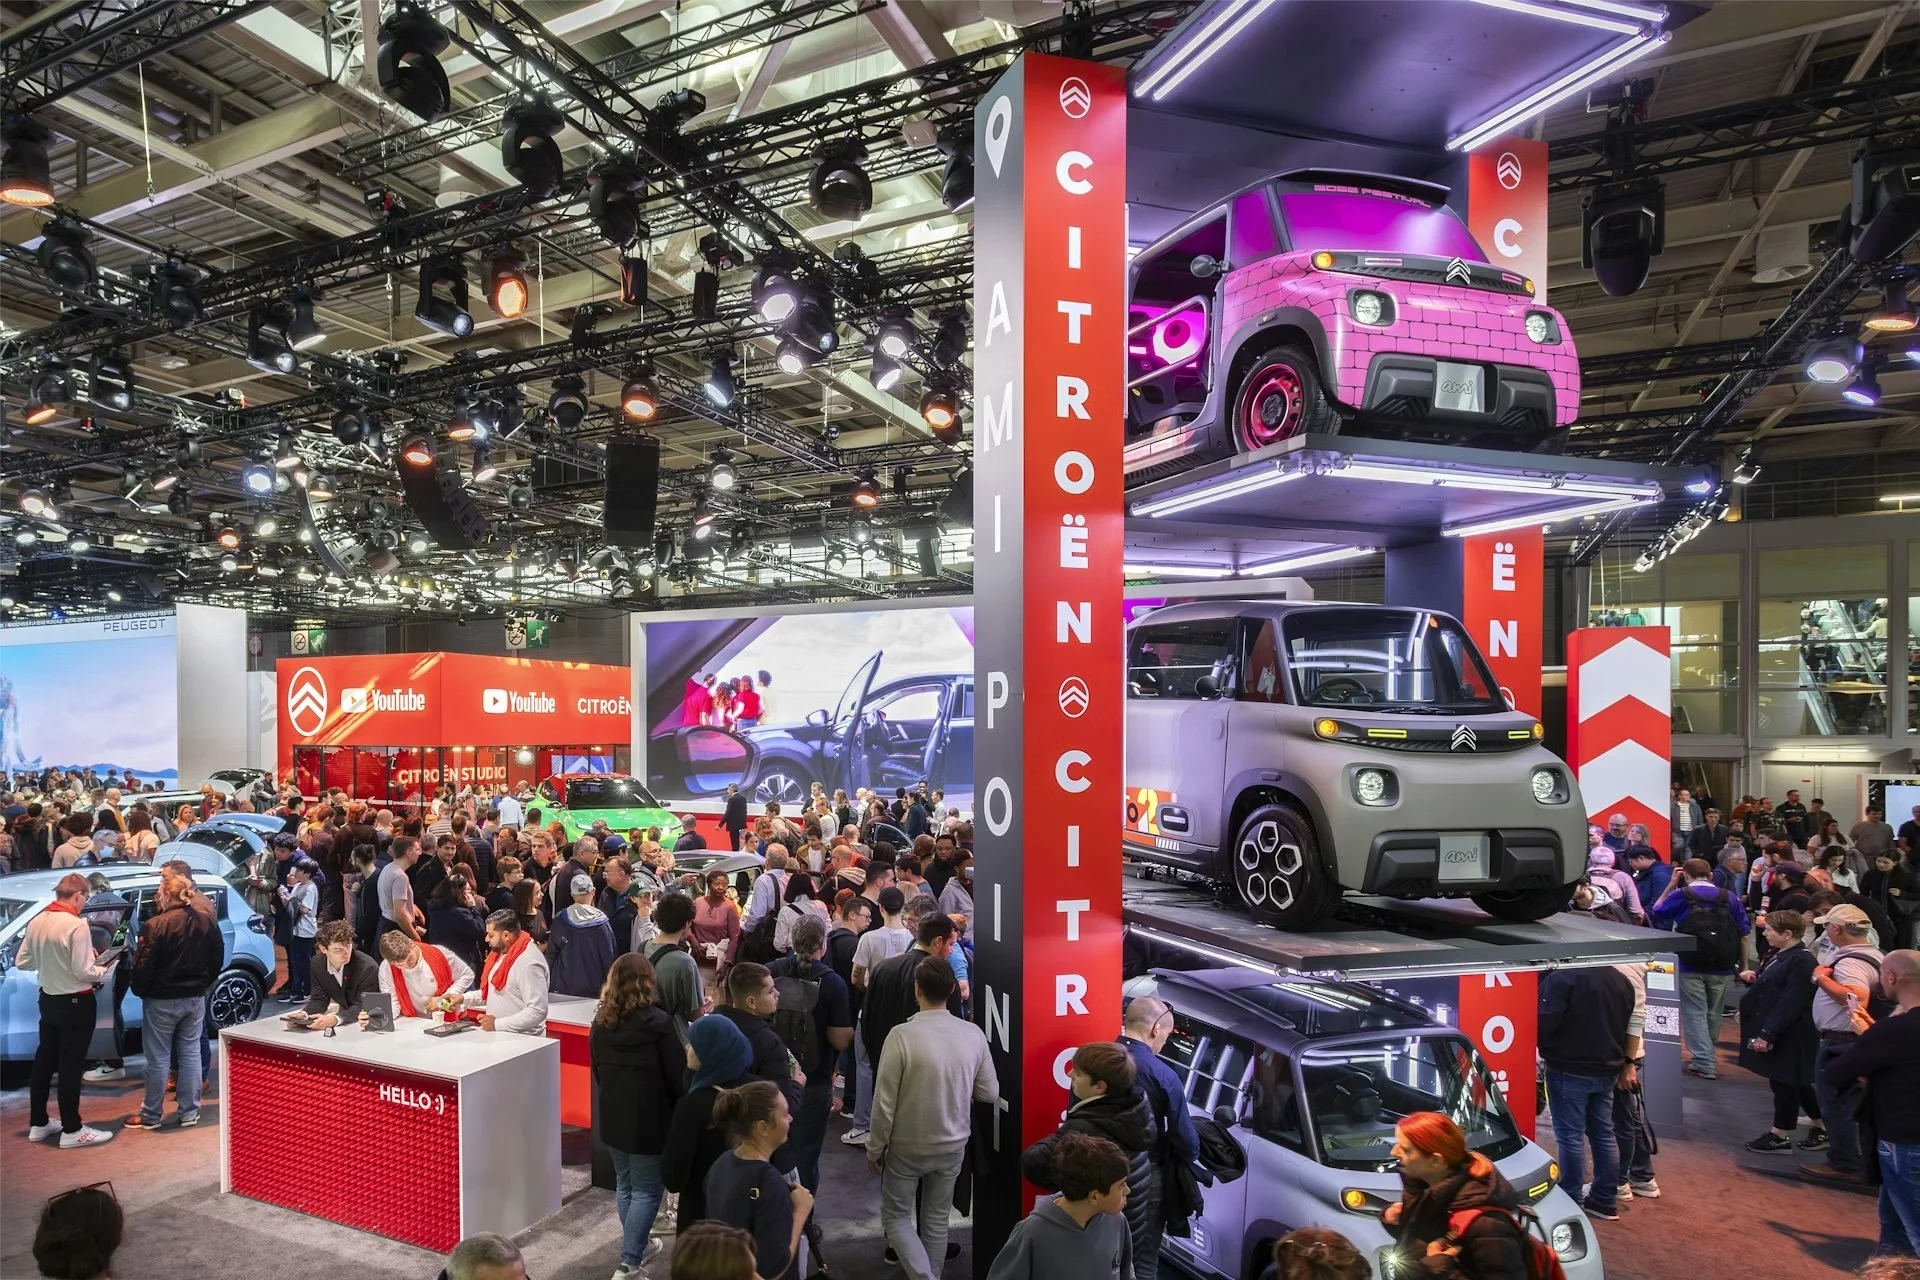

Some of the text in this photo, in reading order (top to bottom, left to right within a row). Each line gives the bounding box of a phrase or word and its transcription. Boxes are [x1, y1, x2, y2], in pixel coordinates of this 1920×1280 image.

[1054, 150, 1095, 643] CITROËN
[1440, 380, 1474, 395] ami
[104, 618, 166, 632] PEUGEOT
[371, 687, 425, 712] YouTube
[509, 690, 556, 713] YouTube
[462, 766, 507, 781] STUDIO
[1444, 846, 1478, 863] ami
[379, 1084, 432, 1110] HELLO
